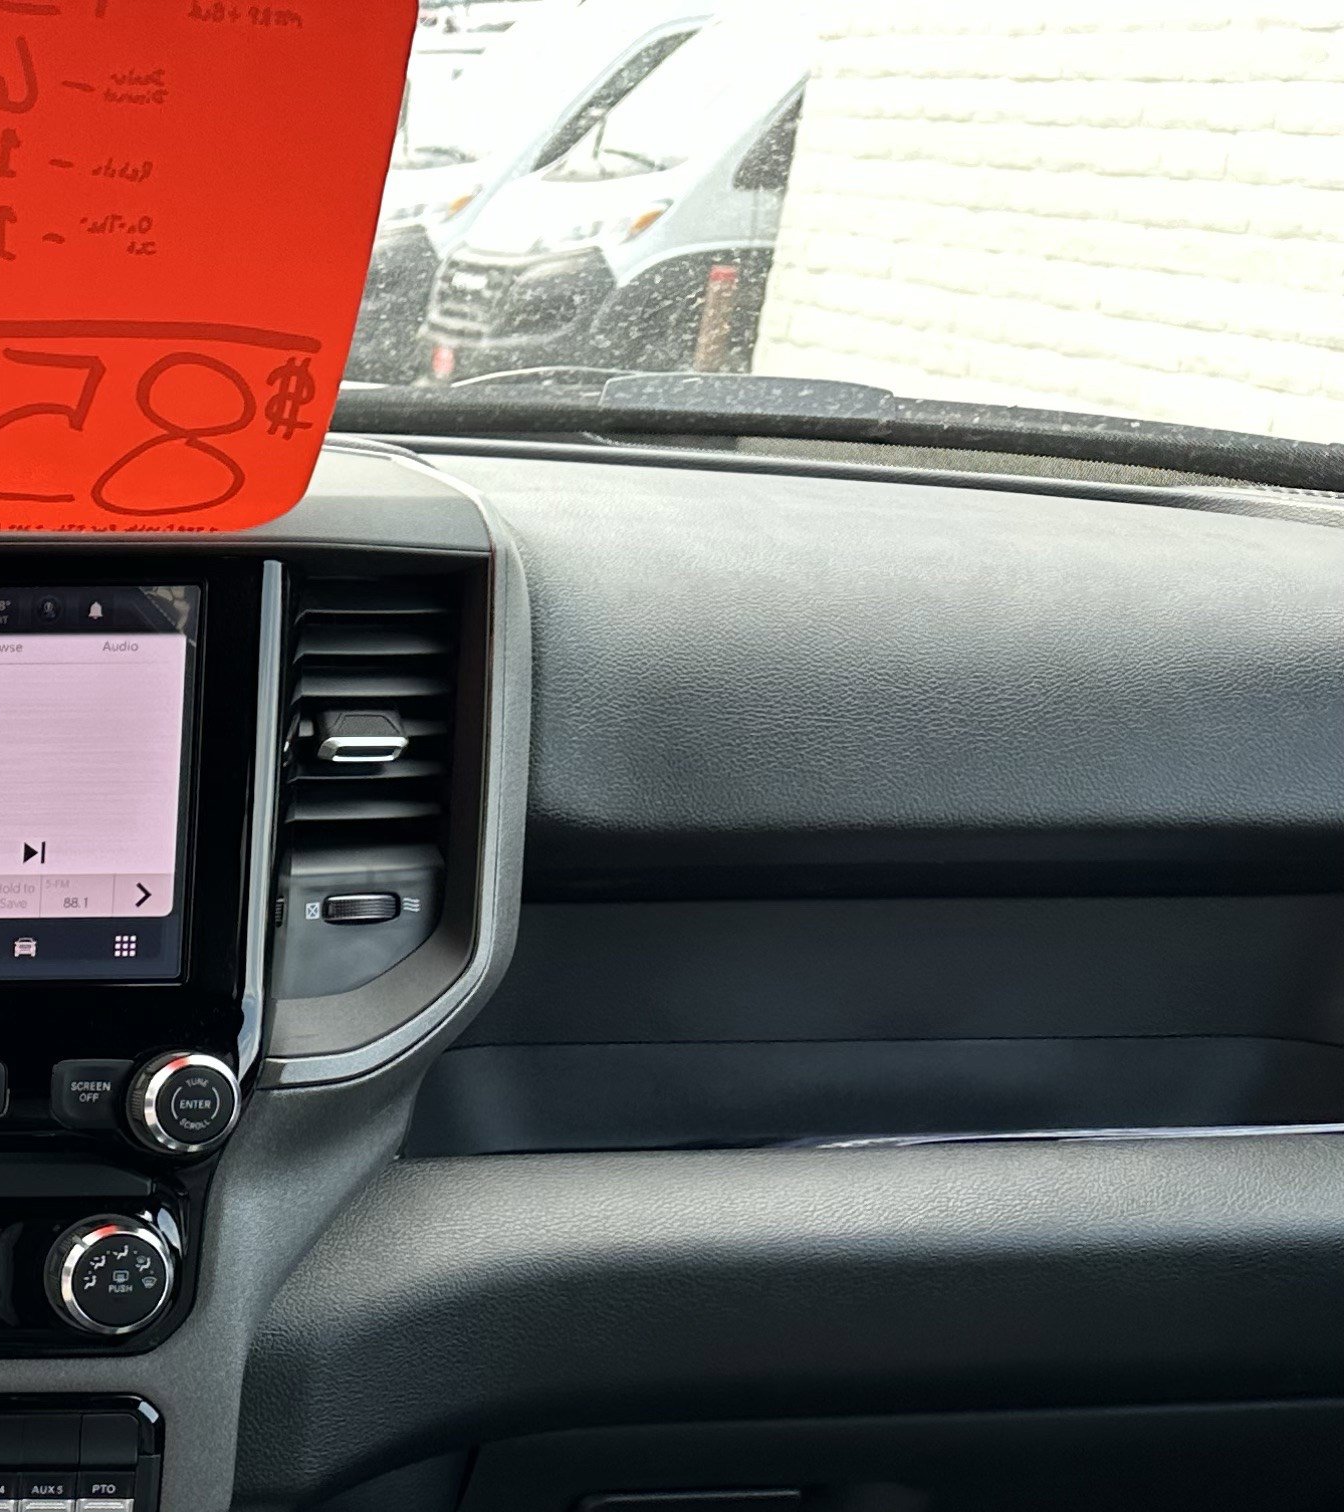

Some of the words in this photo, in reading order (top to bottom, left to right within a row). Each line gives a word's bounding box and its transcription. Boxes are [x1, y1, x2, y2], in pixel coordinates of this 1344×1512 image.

[102, 640, 139, 652] Audio
[23, 883, 35, 894] to
[0, 898, 28, 910] Save
[62, 897, 89, 909] 88.1
[70, 1081, 111, 1092] SCREEN
[186, 1078, 209, 1088] TUNE
[78, 1092, 100, 1103] OFF
[179, 1099, 211, 1110] ENTER
[179, 1117, 211, 1130] SCROLL
[108, 1283, 133, 1294] PUSH
[31, 1484, 54, 1494] AUX
[91, 1484, 116, 1494] PTO
